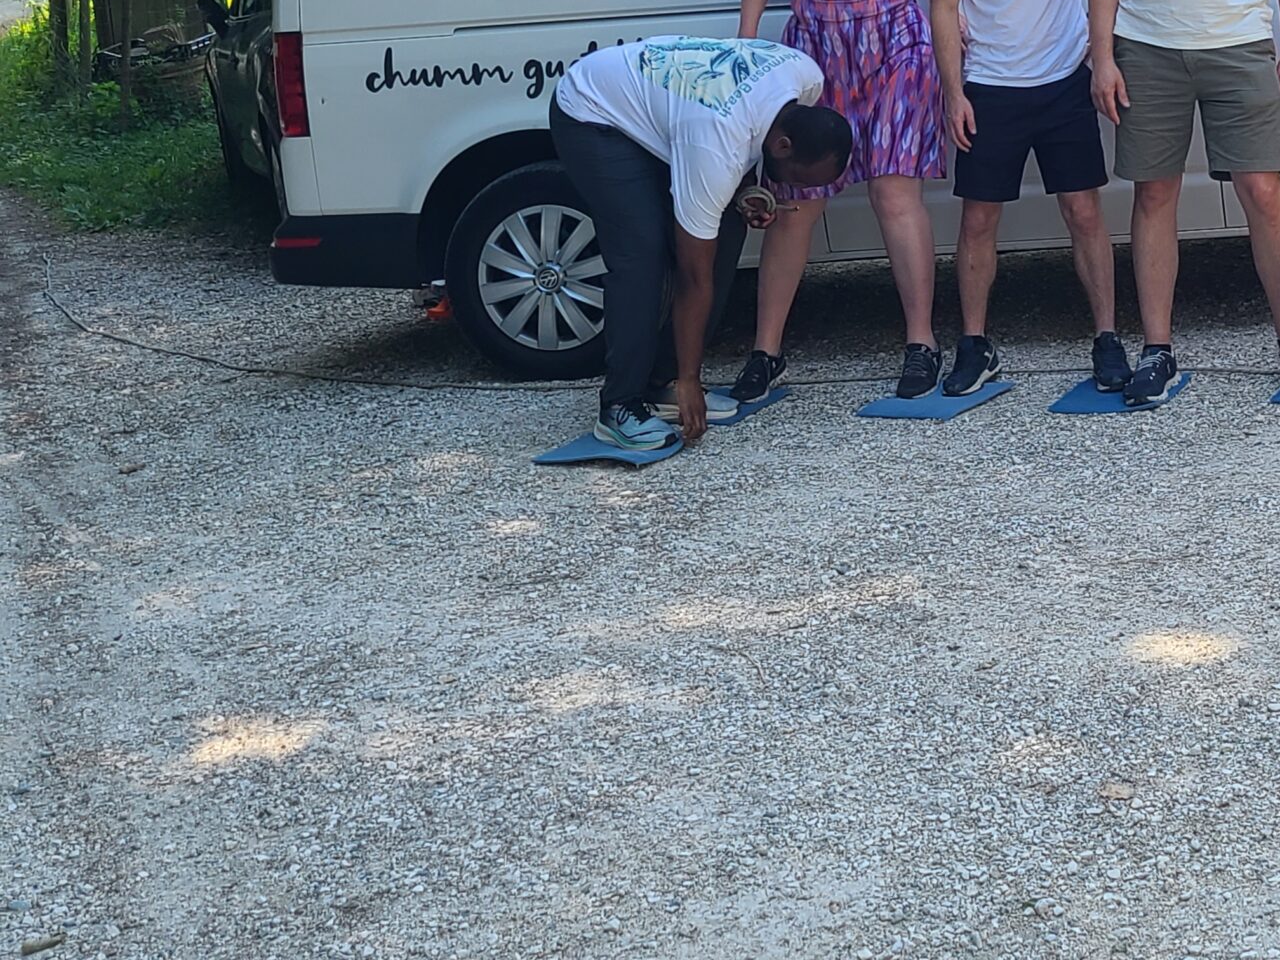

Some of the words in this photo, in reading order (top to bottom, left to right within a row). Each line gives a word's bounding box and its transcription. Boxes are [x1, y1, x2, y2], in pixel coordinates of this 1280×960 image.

[365, 46, 514, 93] chumm
[749, 52, 801, 82] Hermosa
[719, 83, 752, 118] Beach
